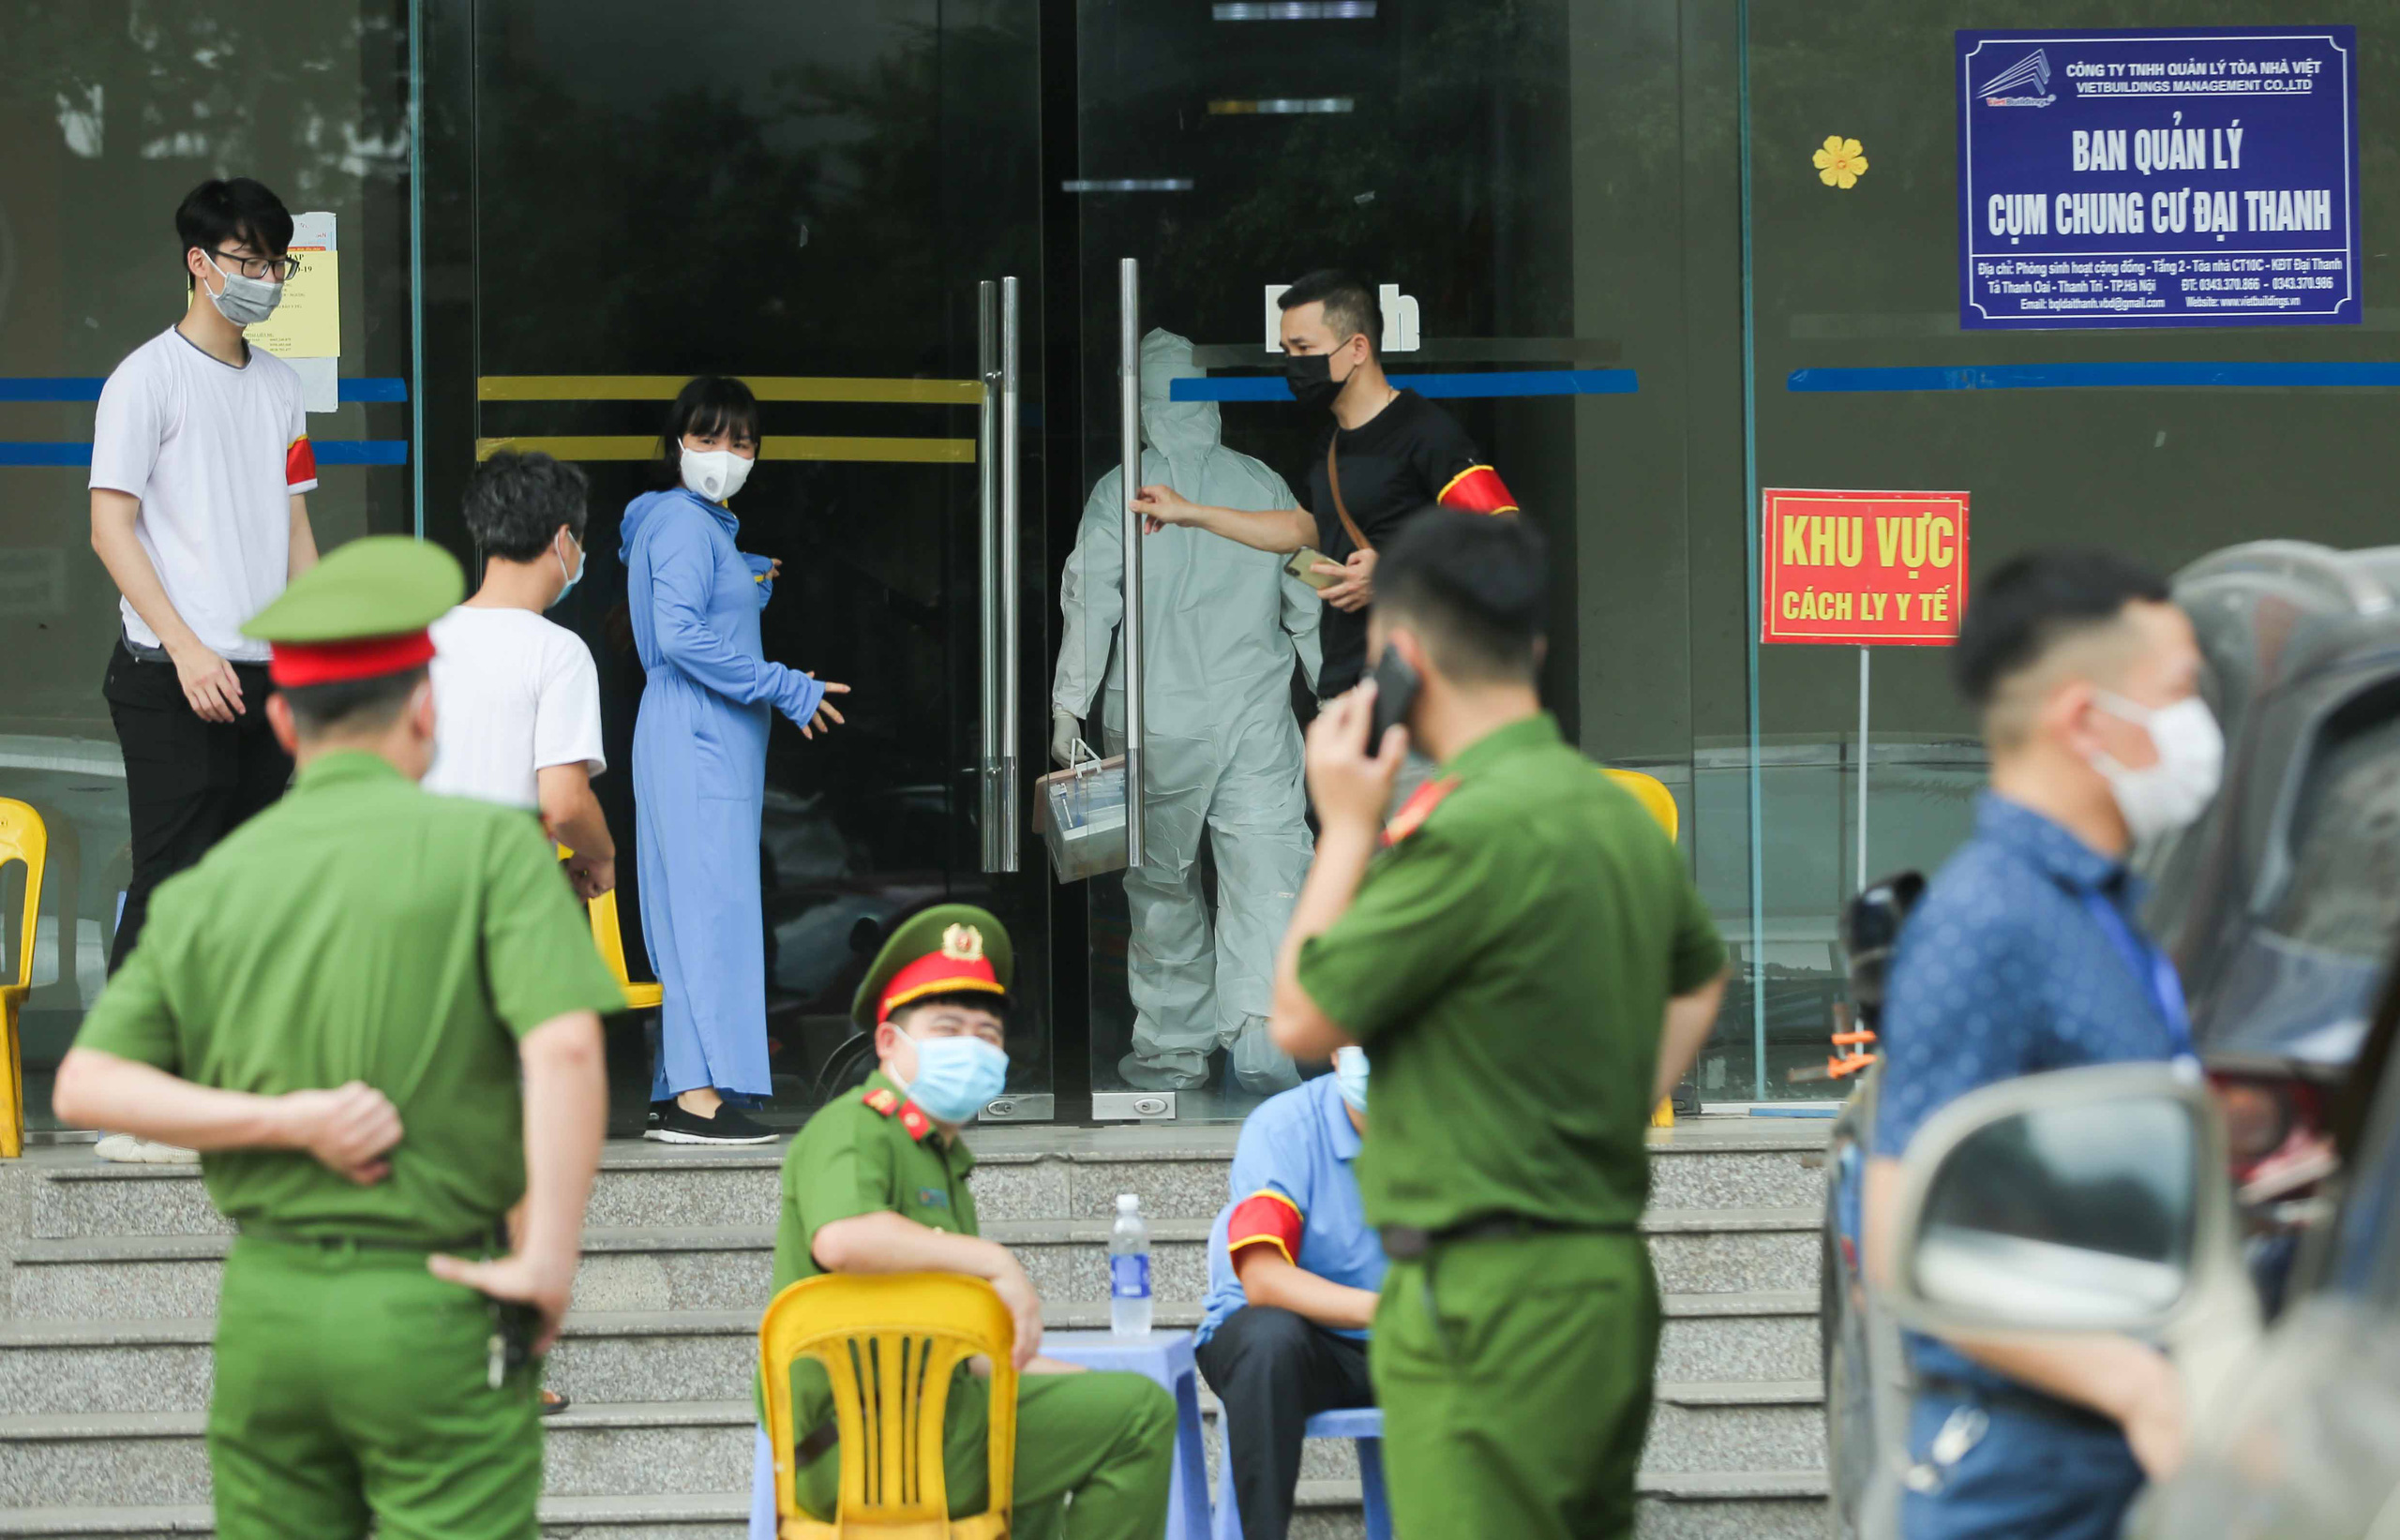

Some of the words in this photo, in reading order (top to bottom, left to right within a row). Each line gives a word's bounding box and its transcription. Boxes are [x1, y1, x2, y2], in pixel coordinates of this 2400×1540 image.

[2066, 61, 2105, 77] CÔNG
[2108, 64, 2124, 77] TY
[2128, 63, 2165, 77] TNHH
[2168, 57, 2207, 76] QUẢN
[2210, 59, 2227, 75] LÝ
[2228, 59, 2258, 75] TÒA
[2260, 58, 2289, 75] NHÀ
[2291, 58, 2322, 77] VIỆT
[2077, 81, 2170, 93] VIETBUILDINGS
[2172, 80, 2262, 92] MANAGEMENT
[2264, 79, 2313, 92] CO.,LTD
[2073, 128, 2127, 172] BAN
[2134, 111, 2206, 175] QUẢN
[2212, 119, 2243, 170] LÝ
[1988, 193, 2048, 245] CỤM
[2055, 192, 2145, 234] CHUNG
[2151, 187, 2190, 233] CƯ
[2192, 190, 2239, 242] ĐẠI
[2244, 189, 2332, 232] THANH
[1977, 262, 1995, 278] Địa
[2016, 262, 2048, 277] Phòng
[2048, 262, 2070, 274] sinh
[2071, 262, 2093, 277] hoạt
[2094, 261, 2119, 277] cộng
[2121, 259, 2145, 276] đồng
[2152, 258, 2178, 276] Tầng
[2178, 260, 2185, 272] 2
[2192, 259, 2211, 272] Tòa
[2212, 259, 2231, 272] nhà
[2272, 258, 2292, 271] KĐT
[2293, 258, 2311, 274] Đại
[2311, 257, 2343, 271] Thanh
[2002, 281, 2032, 293] Thanh
[2033, 280, 2050, 292] Oai
[2058, 280, 2089, 292] Thanh
[2138, 279, 2156, 294] Nội
[2020, 298, 2048, 309] Email:
[2185, 295, 2219, 307] Website:
[1783, 515, 1863, 567] KHU
[1876, 512, 1954, 579] VỰC
[1782, 585, 1852, 620] CÁCH
[1860, 592, 1888, 620] LY
[1895, 593, 1912, 620] Y
[1919, 584, 1952, 621] TẾ
